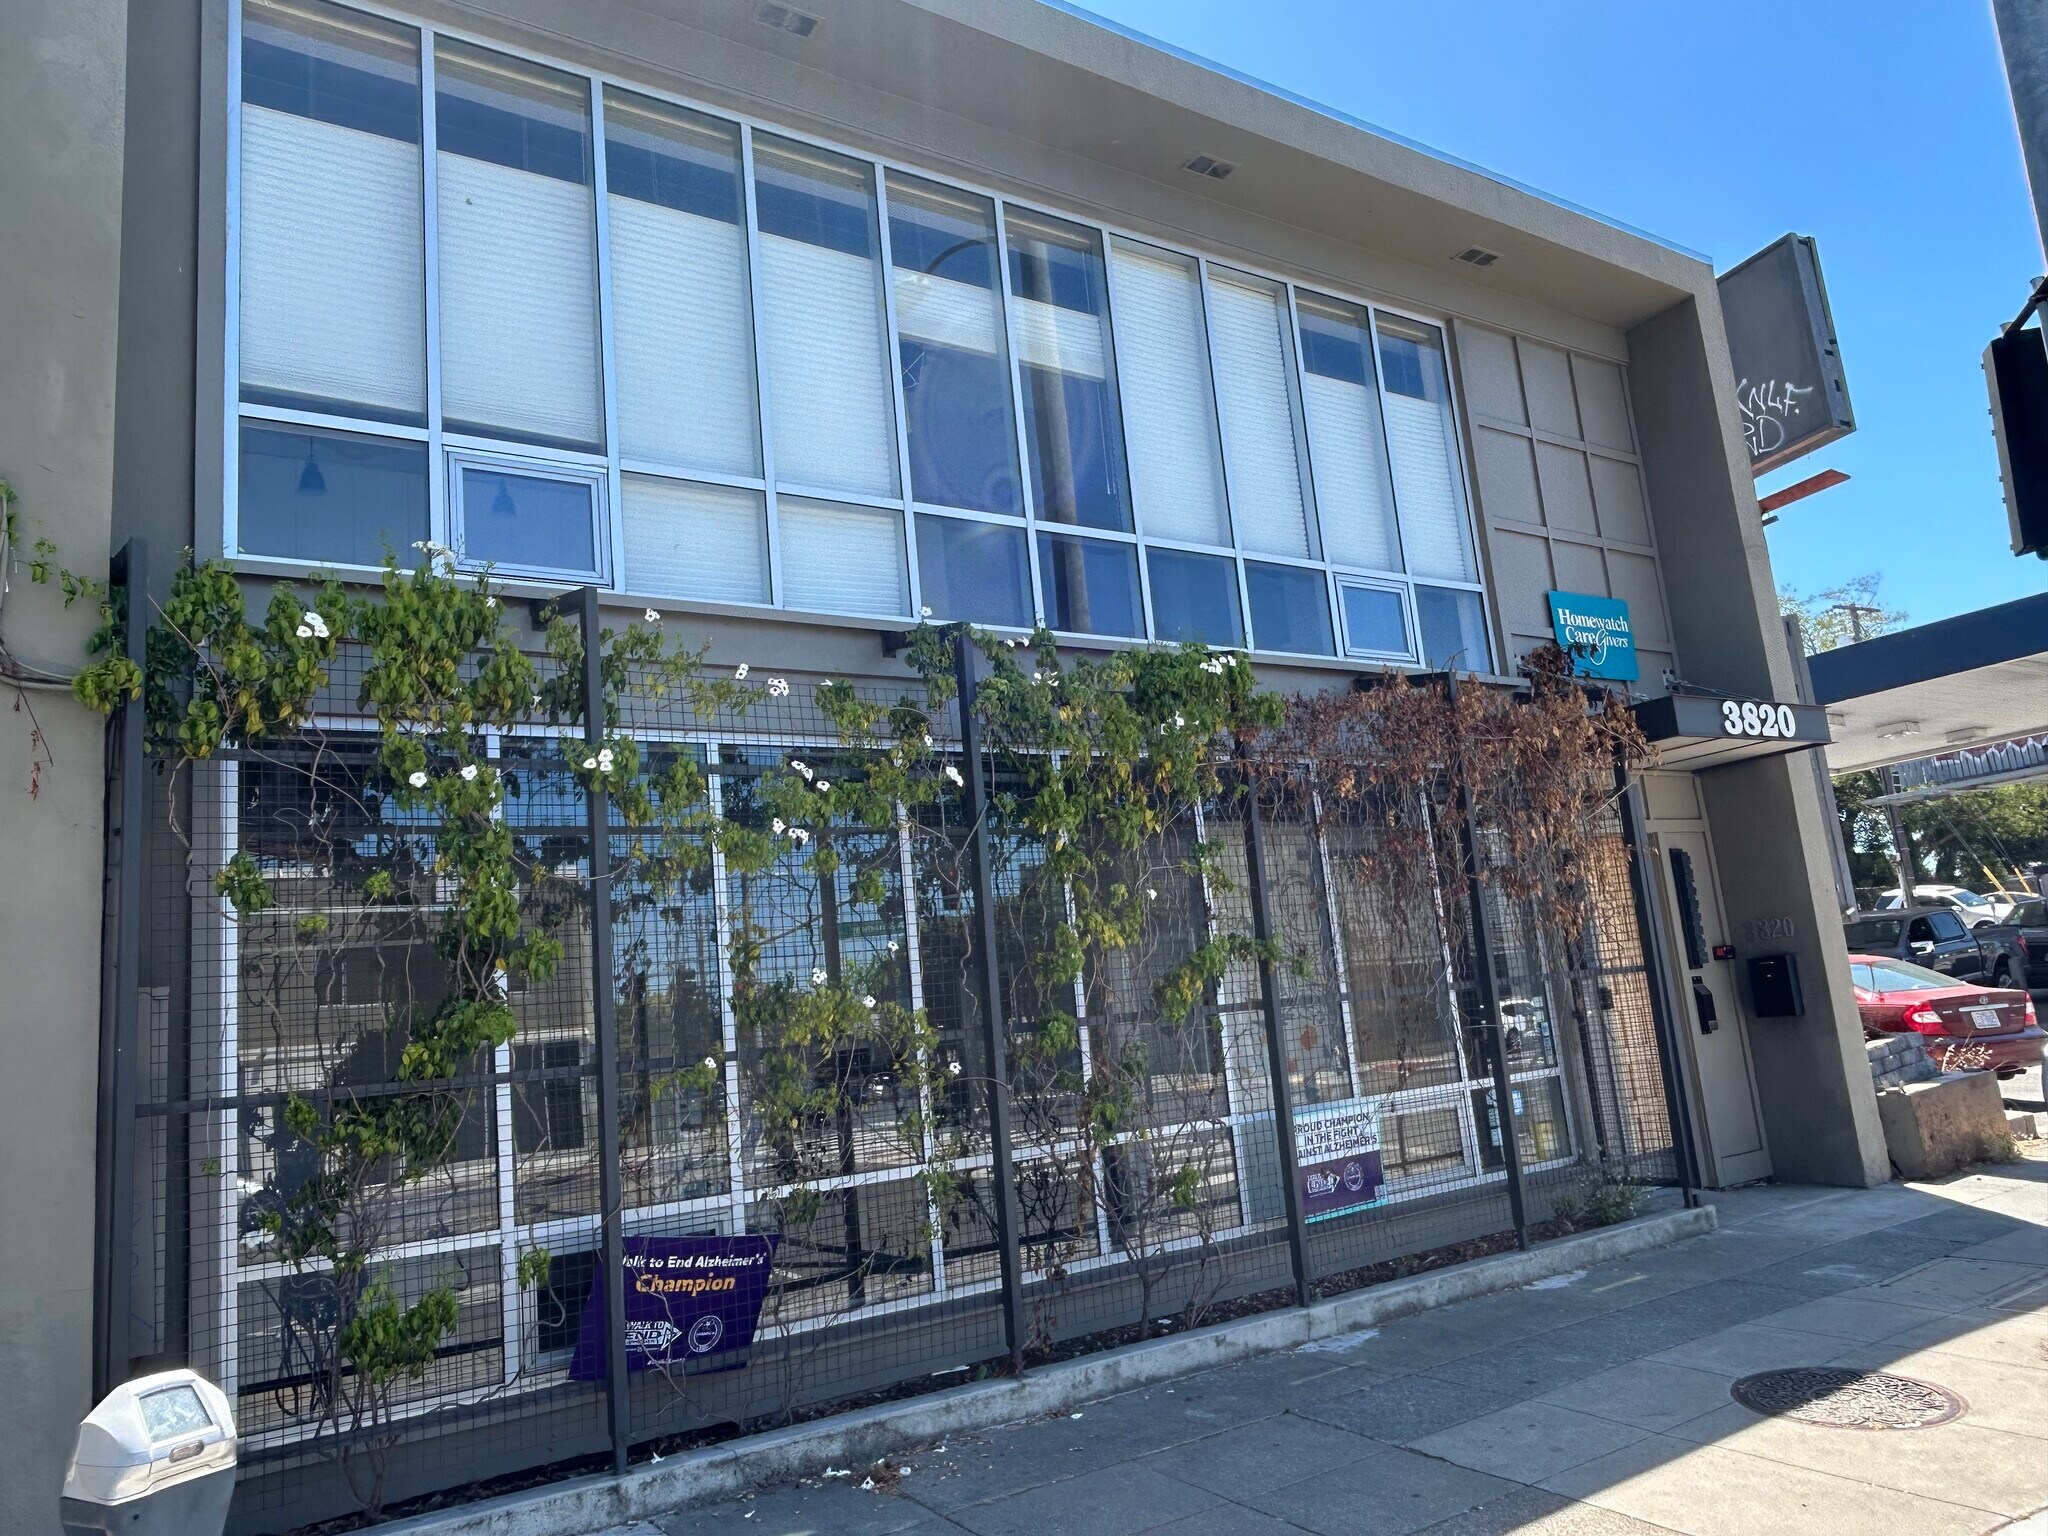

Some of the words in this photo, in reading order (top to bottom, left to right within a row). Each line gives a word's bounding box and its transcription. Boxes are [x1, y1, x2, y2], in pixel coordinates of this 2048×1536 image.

[1557, 608, 1629, 632] Homewatch
[1722, 700, 1796, 738] 3820
[1324, 1112, 1369, 1129] CHAMPION
[1298, 1146, 1323, 1159] AINST
[1324, 1134, 1378, 1154] ALZHEIMER'S
[1304, 1133, 1314, 1146] IN
[1315, 1131, 1332, 1143] THE
[1333, 1126, 1359, 1140] FIGHT
[649, 1257, 664, 1268] to
[667, 1255, 693, 1268] End
[635, 1272, 736, 1297] Champion
[653, 1321, 666, 1329] TO
